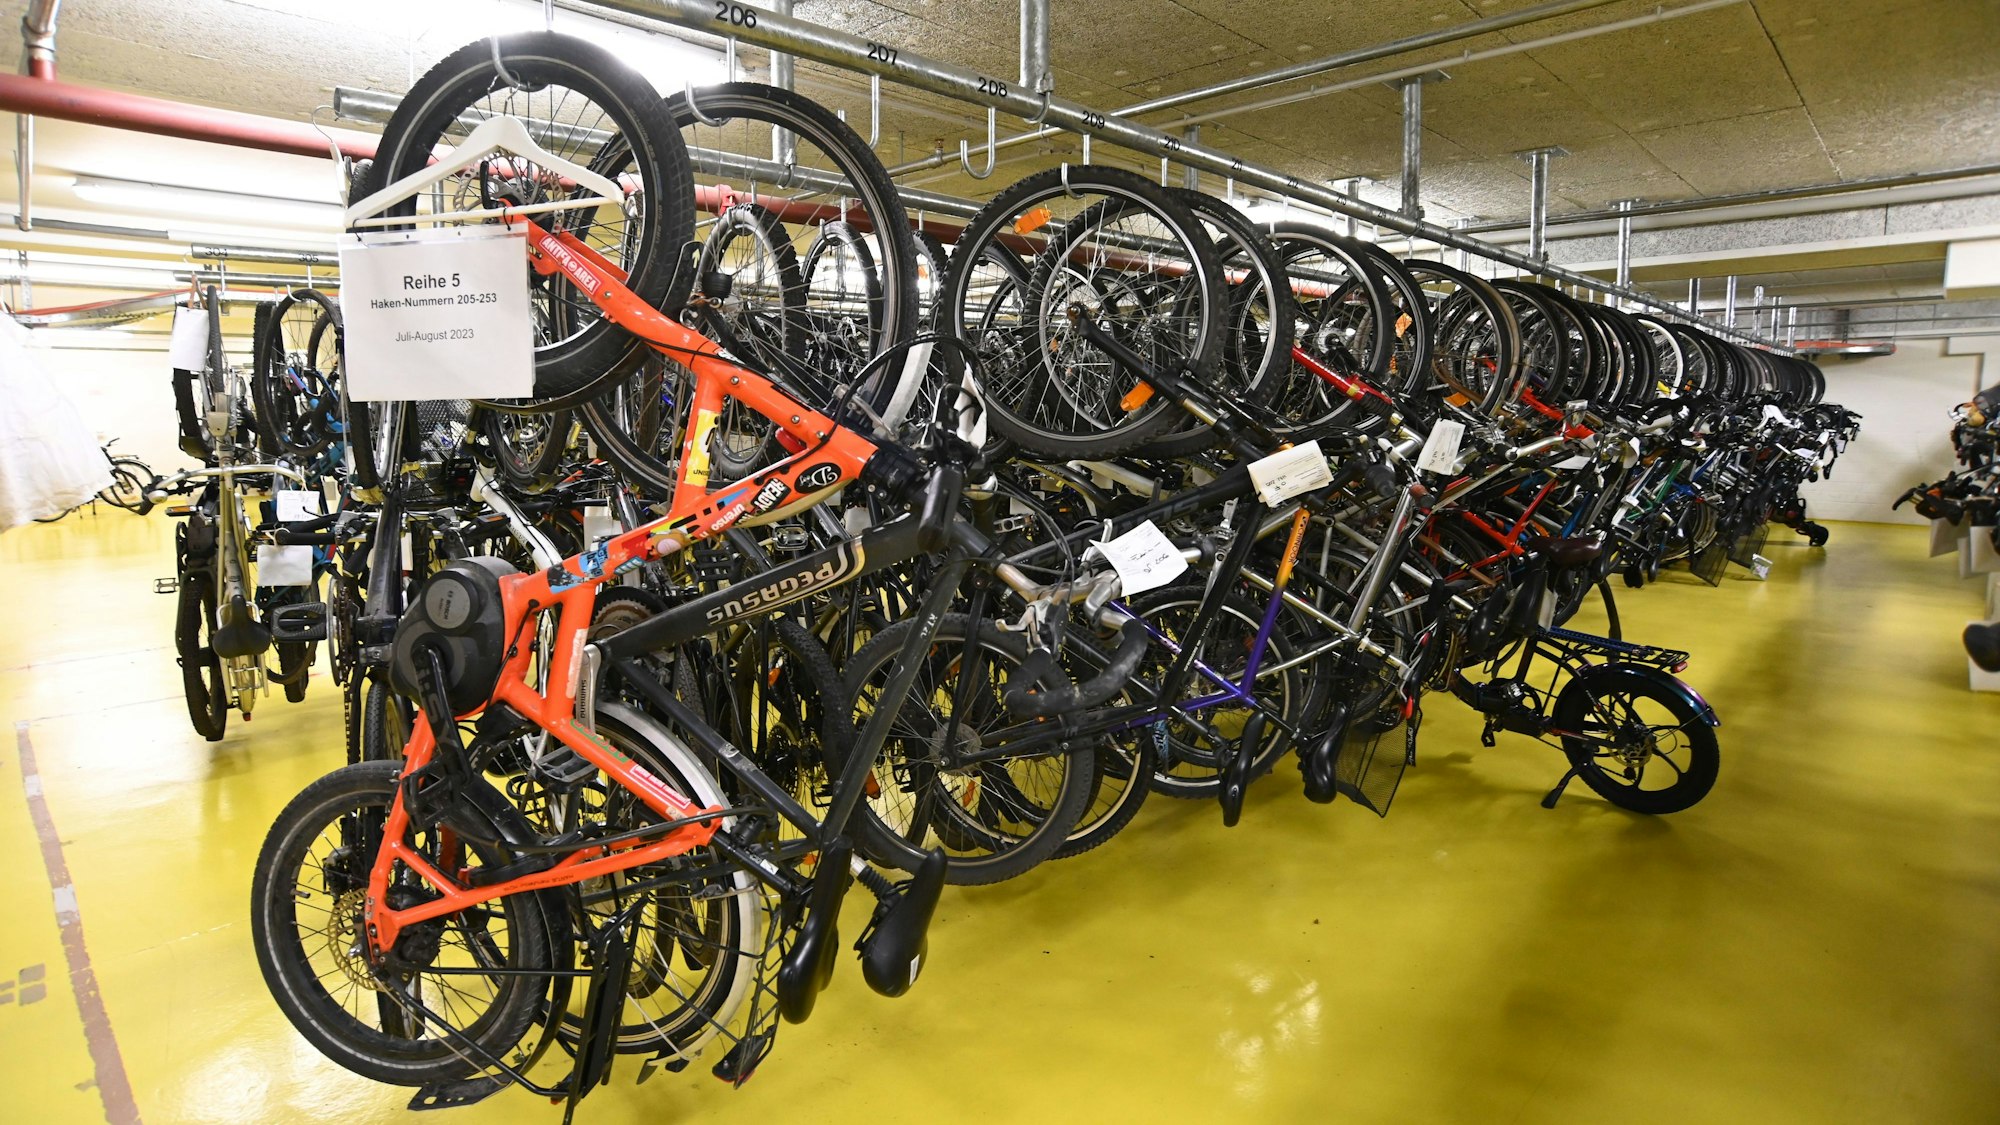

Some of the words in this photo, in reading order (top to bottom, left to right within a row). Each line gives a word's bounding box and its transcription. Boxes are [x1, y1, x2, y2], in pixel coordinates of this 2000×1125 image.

[714, 1, 757, 29] 206
[866, 42, 898, 66] 207
[977, 76, 1008, 98] 208
[1081, 110, 1105, 130] 209
[1163, 135, 1181, 152] 210
[1231, 157, 1243, 172] 211
[205, 246, 229, 257] 304
[299, 253, 320, 263] 305
[541, 236, 572, 268] ANTIFA
[573, 266, 598, 292] AREA
[403, 274, 447, 290] Reihe
[451, 273, 461, 287] 5
[370, 296, 455, 310] Haken-Nummern
[457, 292, 498, 305] 205-253
[395, 330, 448, 343] Juli-August
[450, 328, 475, 340] 2023
[754, 478, 786, 513] READY
[1288, 527, 1305, 564] CHINOOK
[705, 561, 836, 626] PEGASUS
